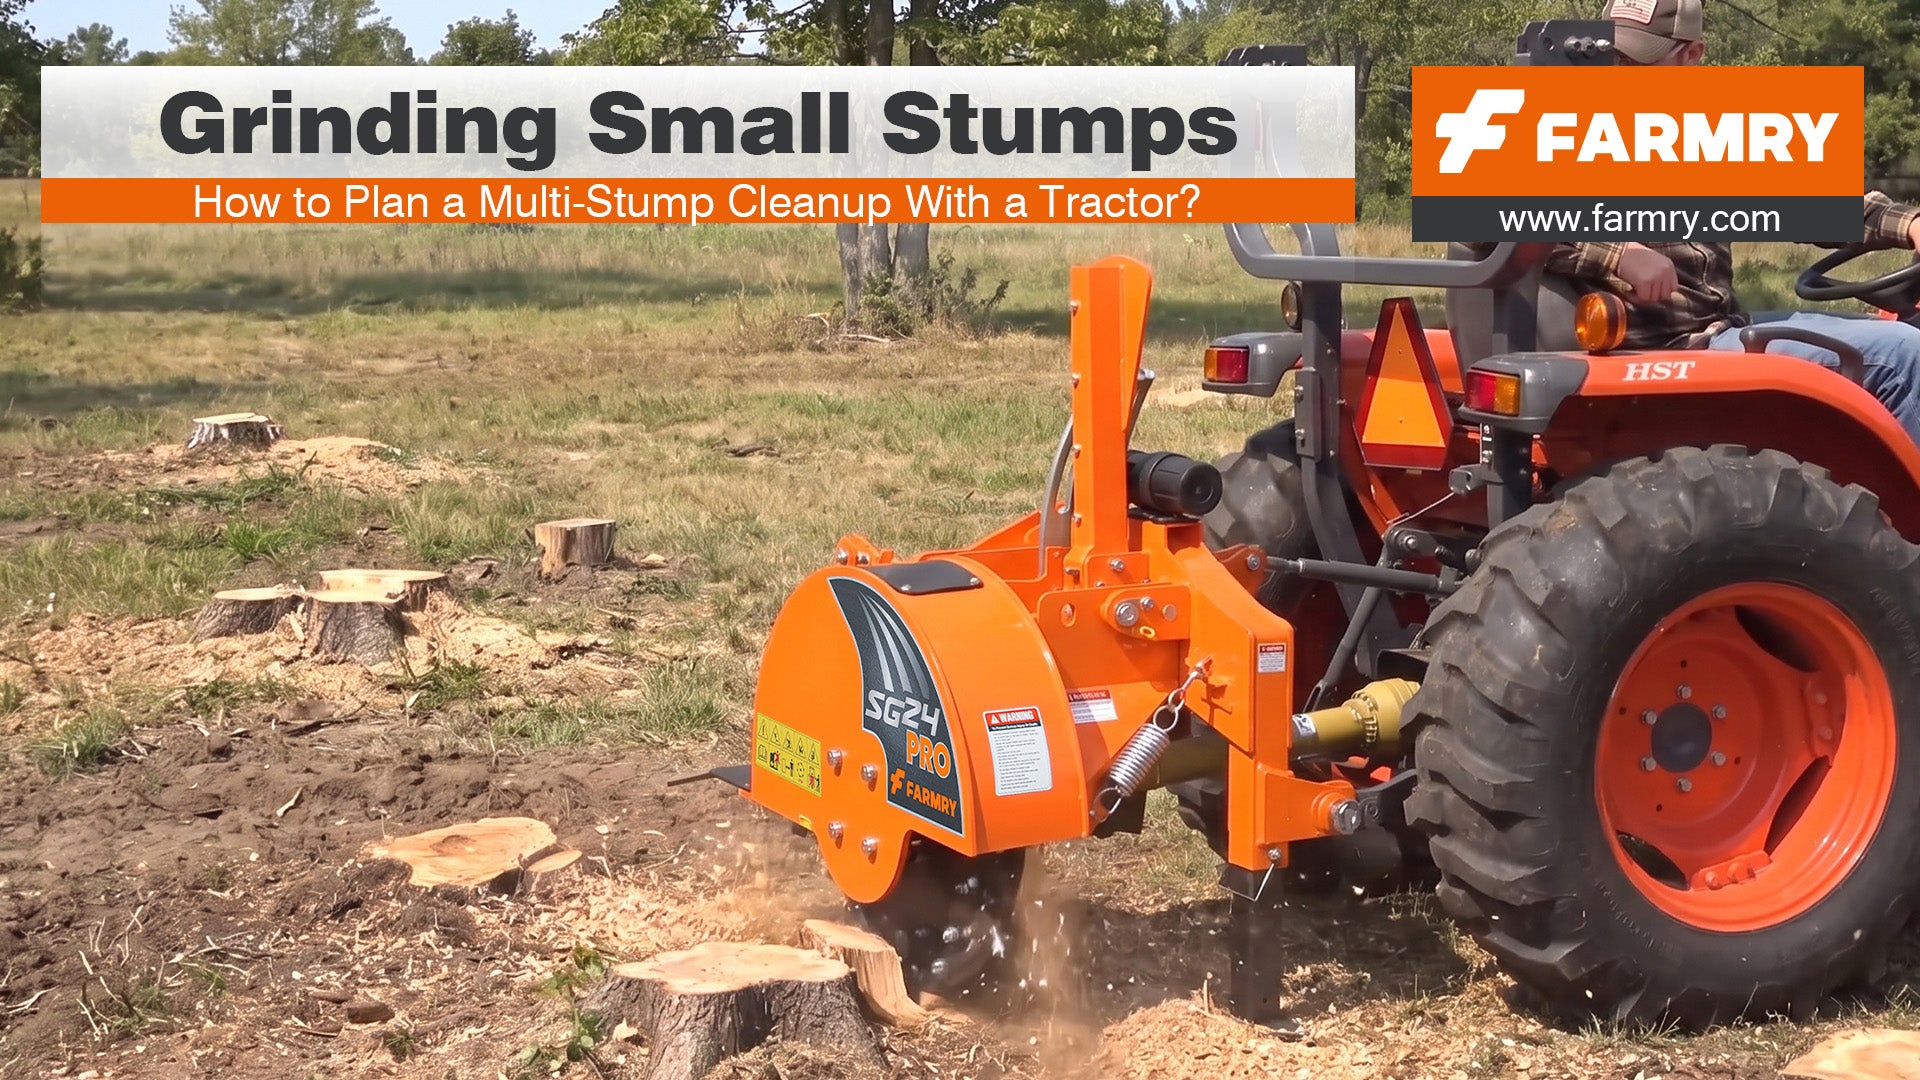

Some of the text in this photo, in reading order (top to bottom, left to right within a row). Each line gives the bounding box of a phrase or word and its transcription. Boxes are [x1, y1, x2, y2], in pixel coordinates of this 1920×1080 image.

[1621, 360, 1696, 382] HST
[864, 689, 941, 737] SG24
[997, 710, 1035, 723] WARNING
[906, 729, 951, 779] PRO
[906, 781, 957, 817] FARMRY
